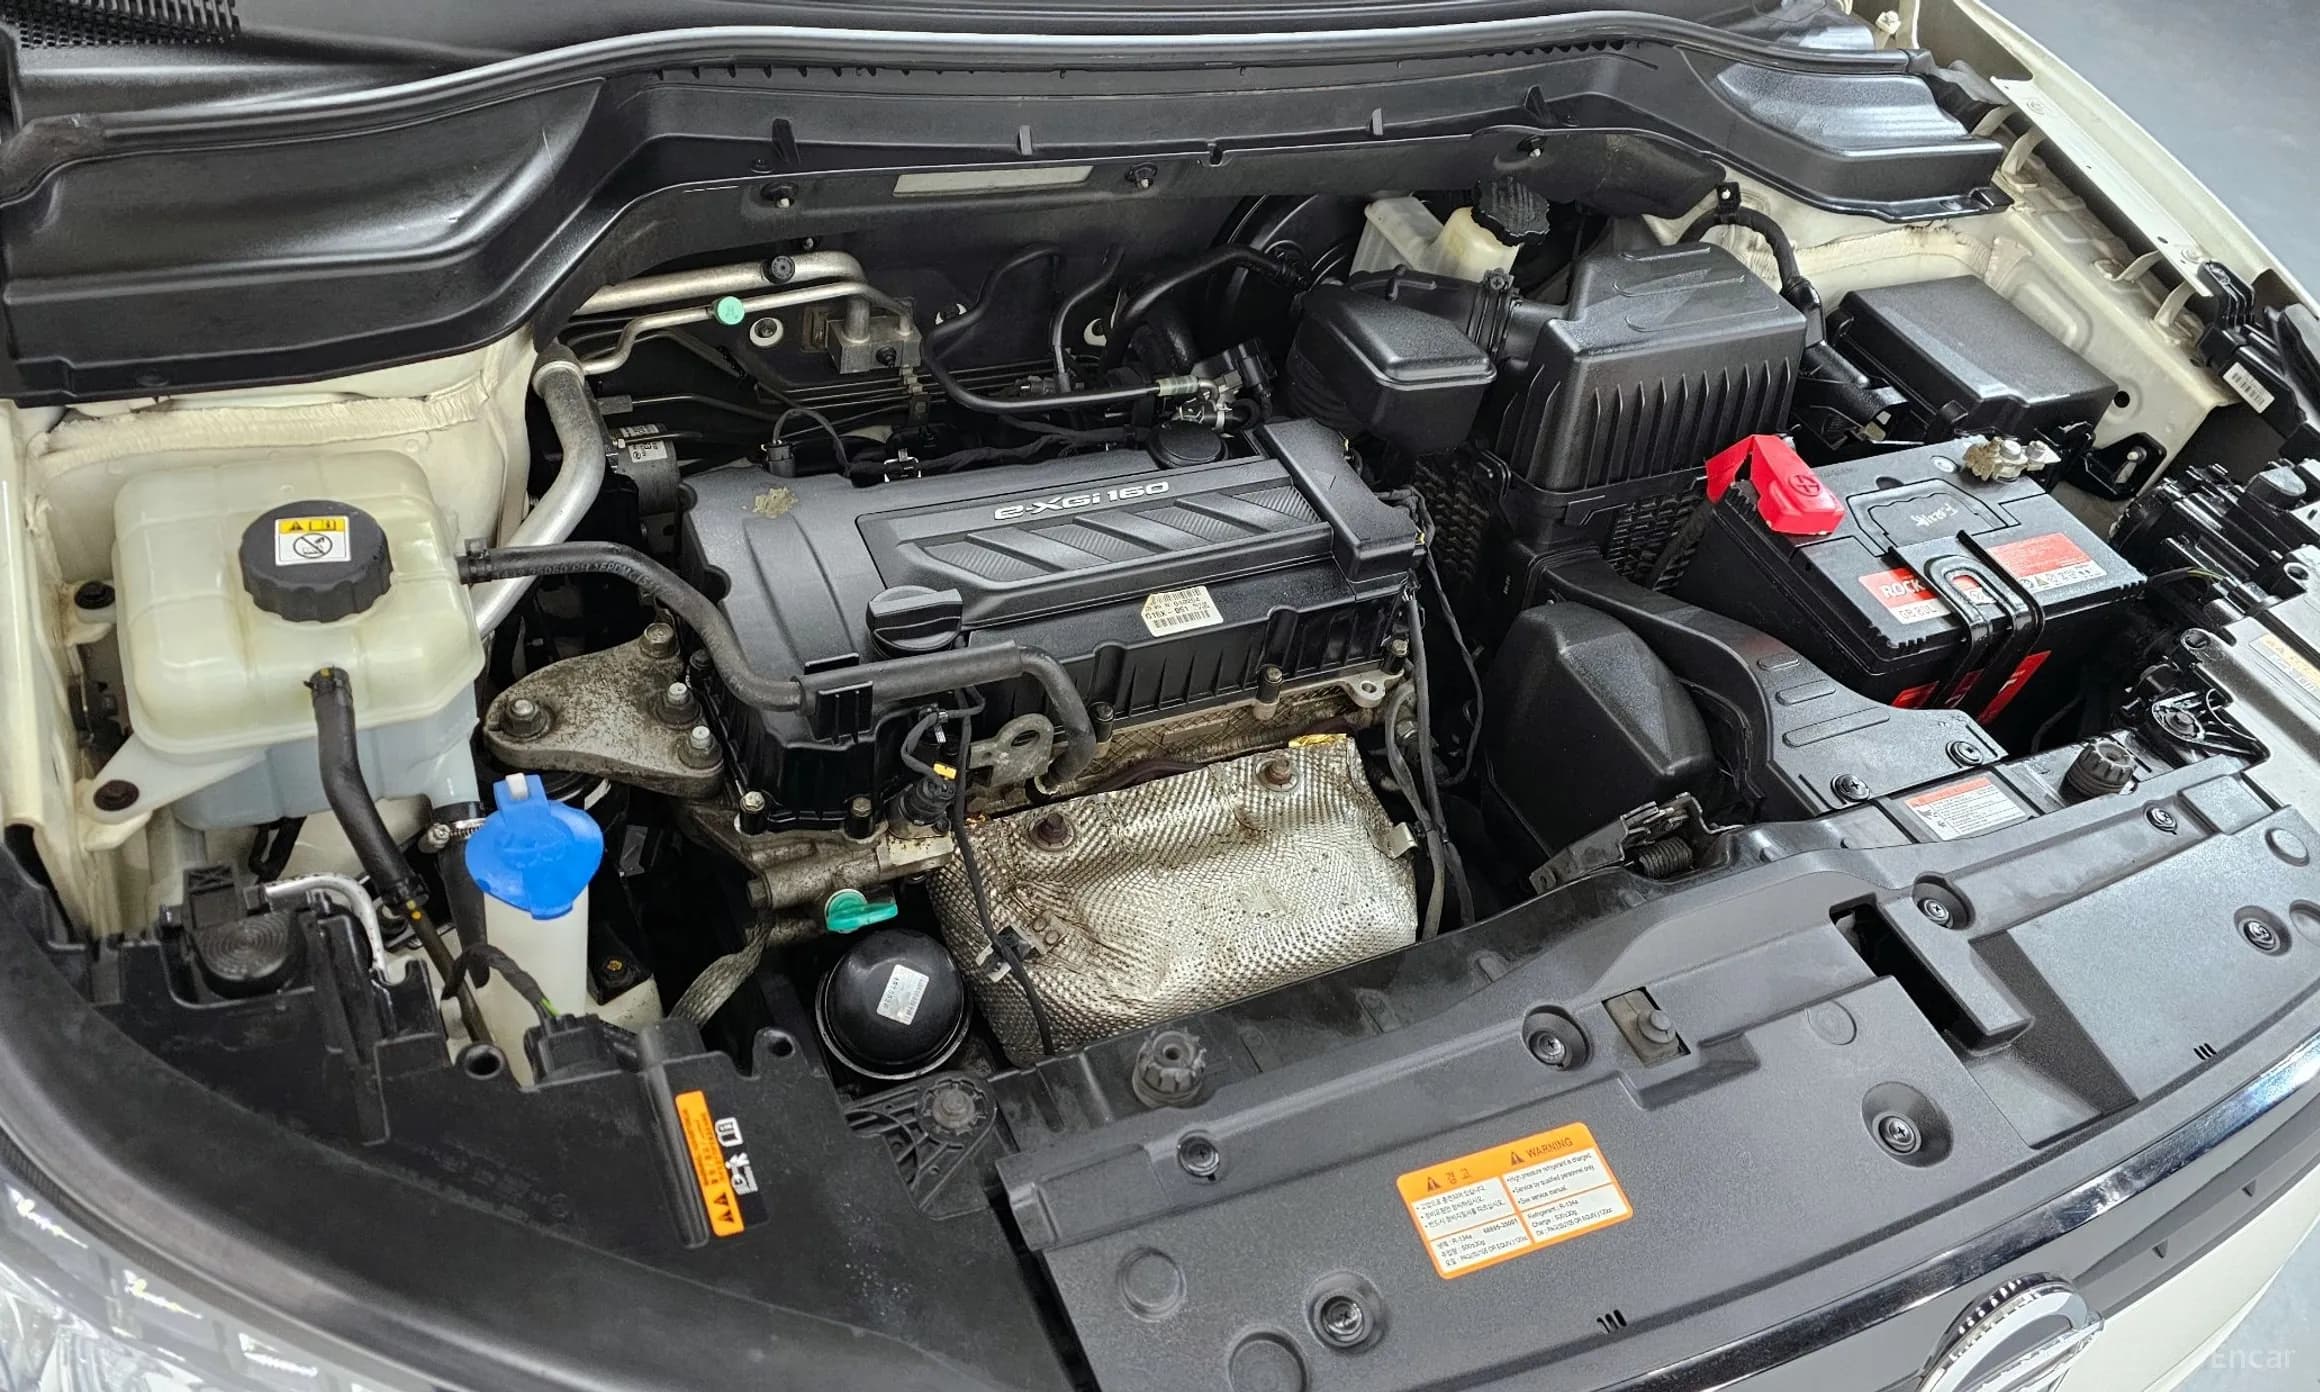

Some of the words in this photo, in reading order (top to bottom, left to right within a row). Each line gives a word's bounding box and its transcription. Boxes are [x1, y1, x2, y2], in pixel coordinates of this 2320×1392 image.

[994, 493, 1101, 520] e-XGi
[1107, 481, 1169, 502] 160
[1526, 1136, 1574, 1159] WARNING
